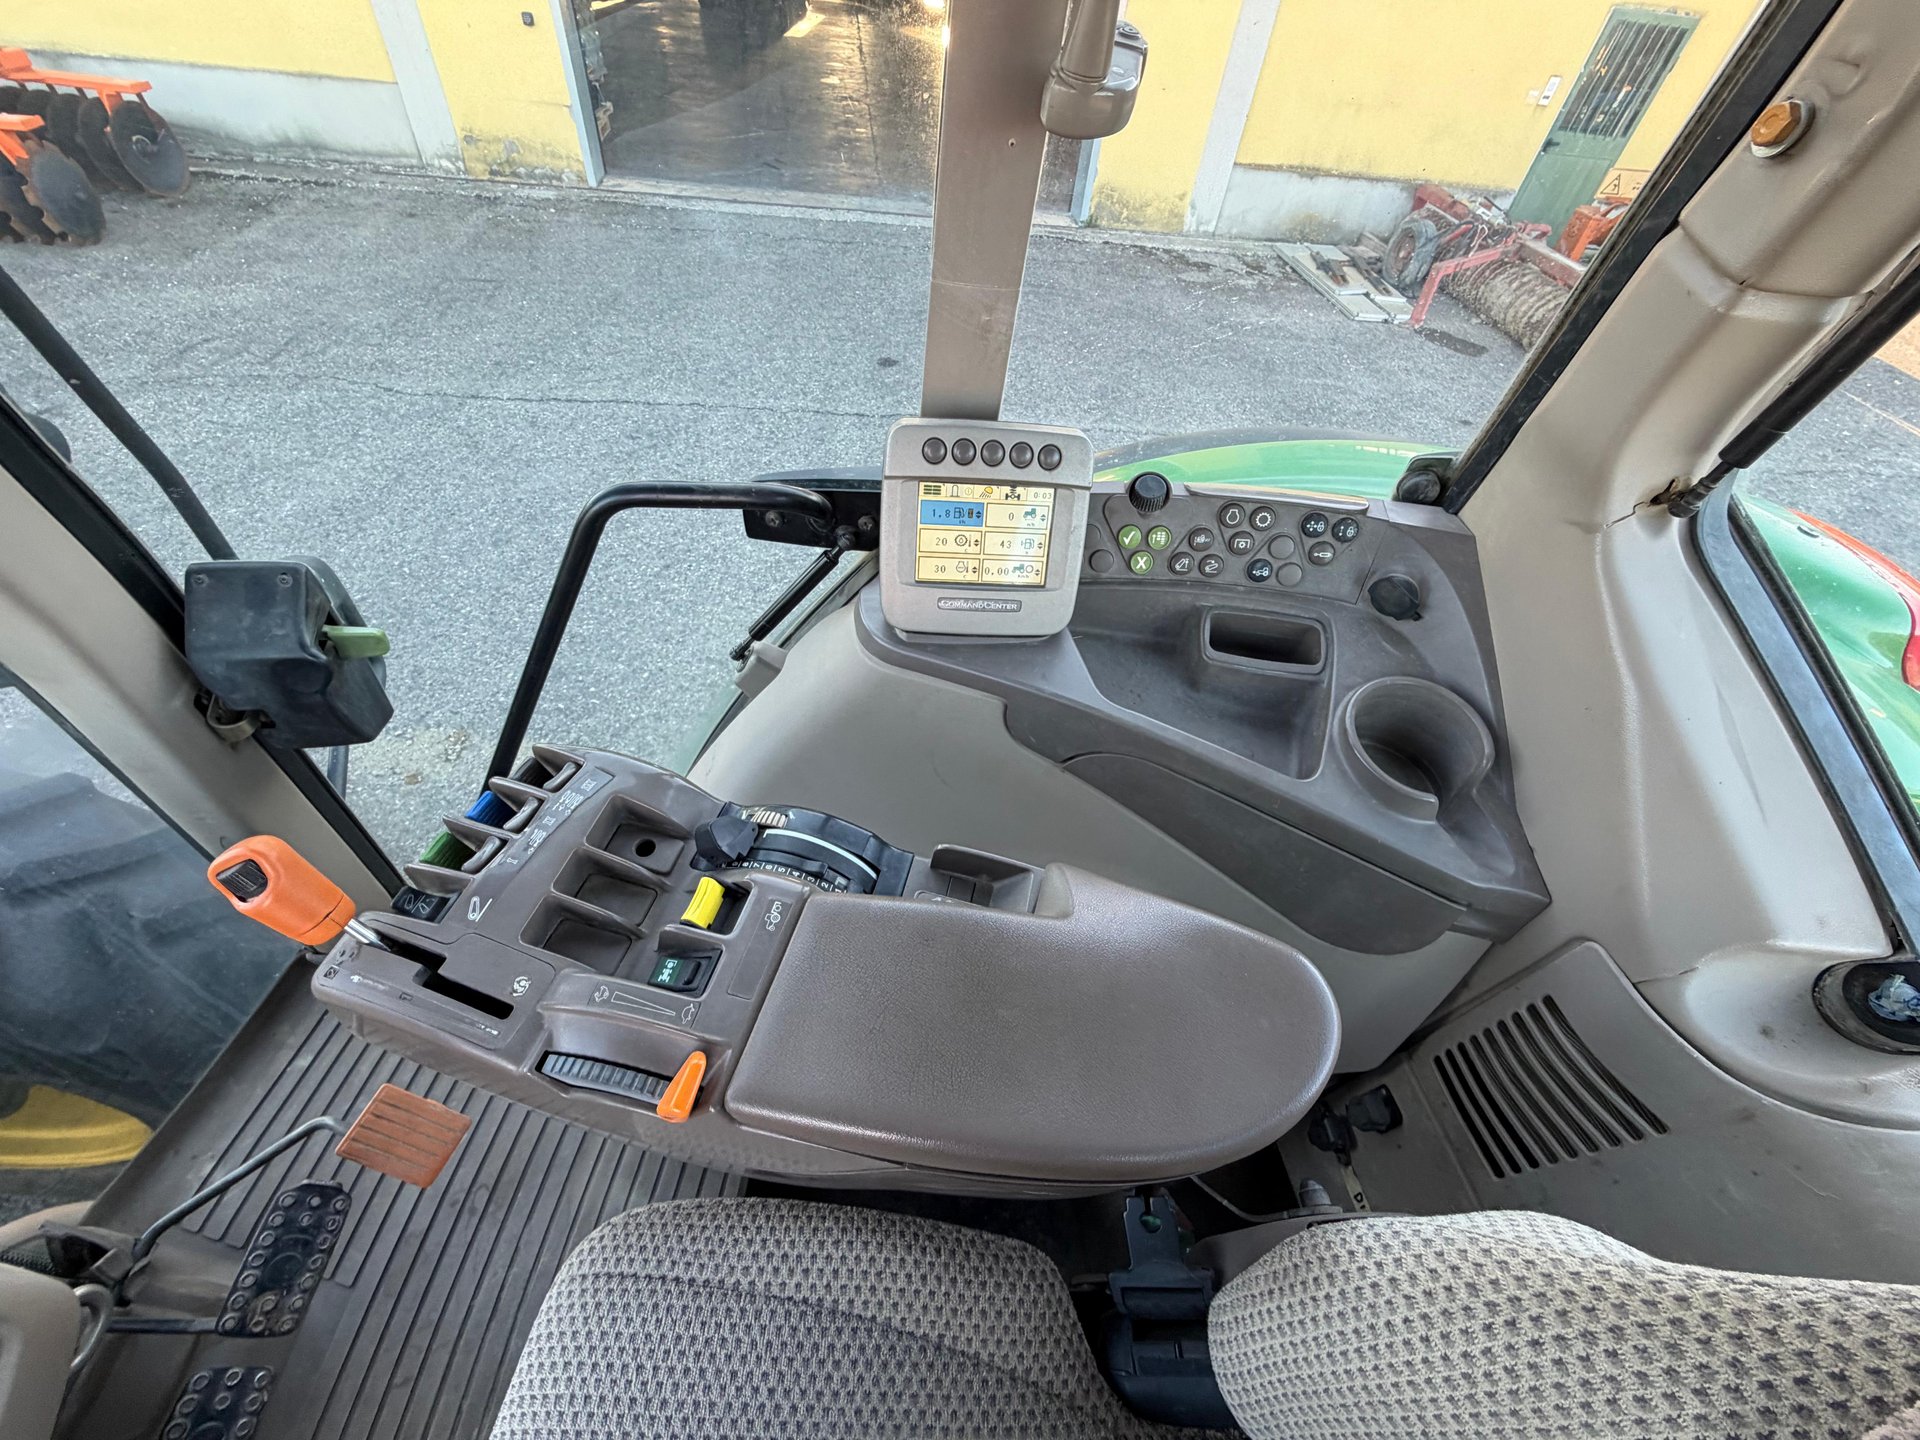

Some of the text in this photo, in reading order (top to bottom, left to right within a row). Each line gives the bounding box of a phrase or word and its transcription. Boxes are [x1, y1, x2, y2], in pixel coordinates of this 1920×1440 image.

[932, 508, 951, 518] 1.8
[1008, 512, 1015, 521] 0
[935, 537, 948, 546] 20
[1000, 540, 1012, 550] 43
[934, 564, 946, 573] 30
[984, 567, 1009, 576] 0.00
